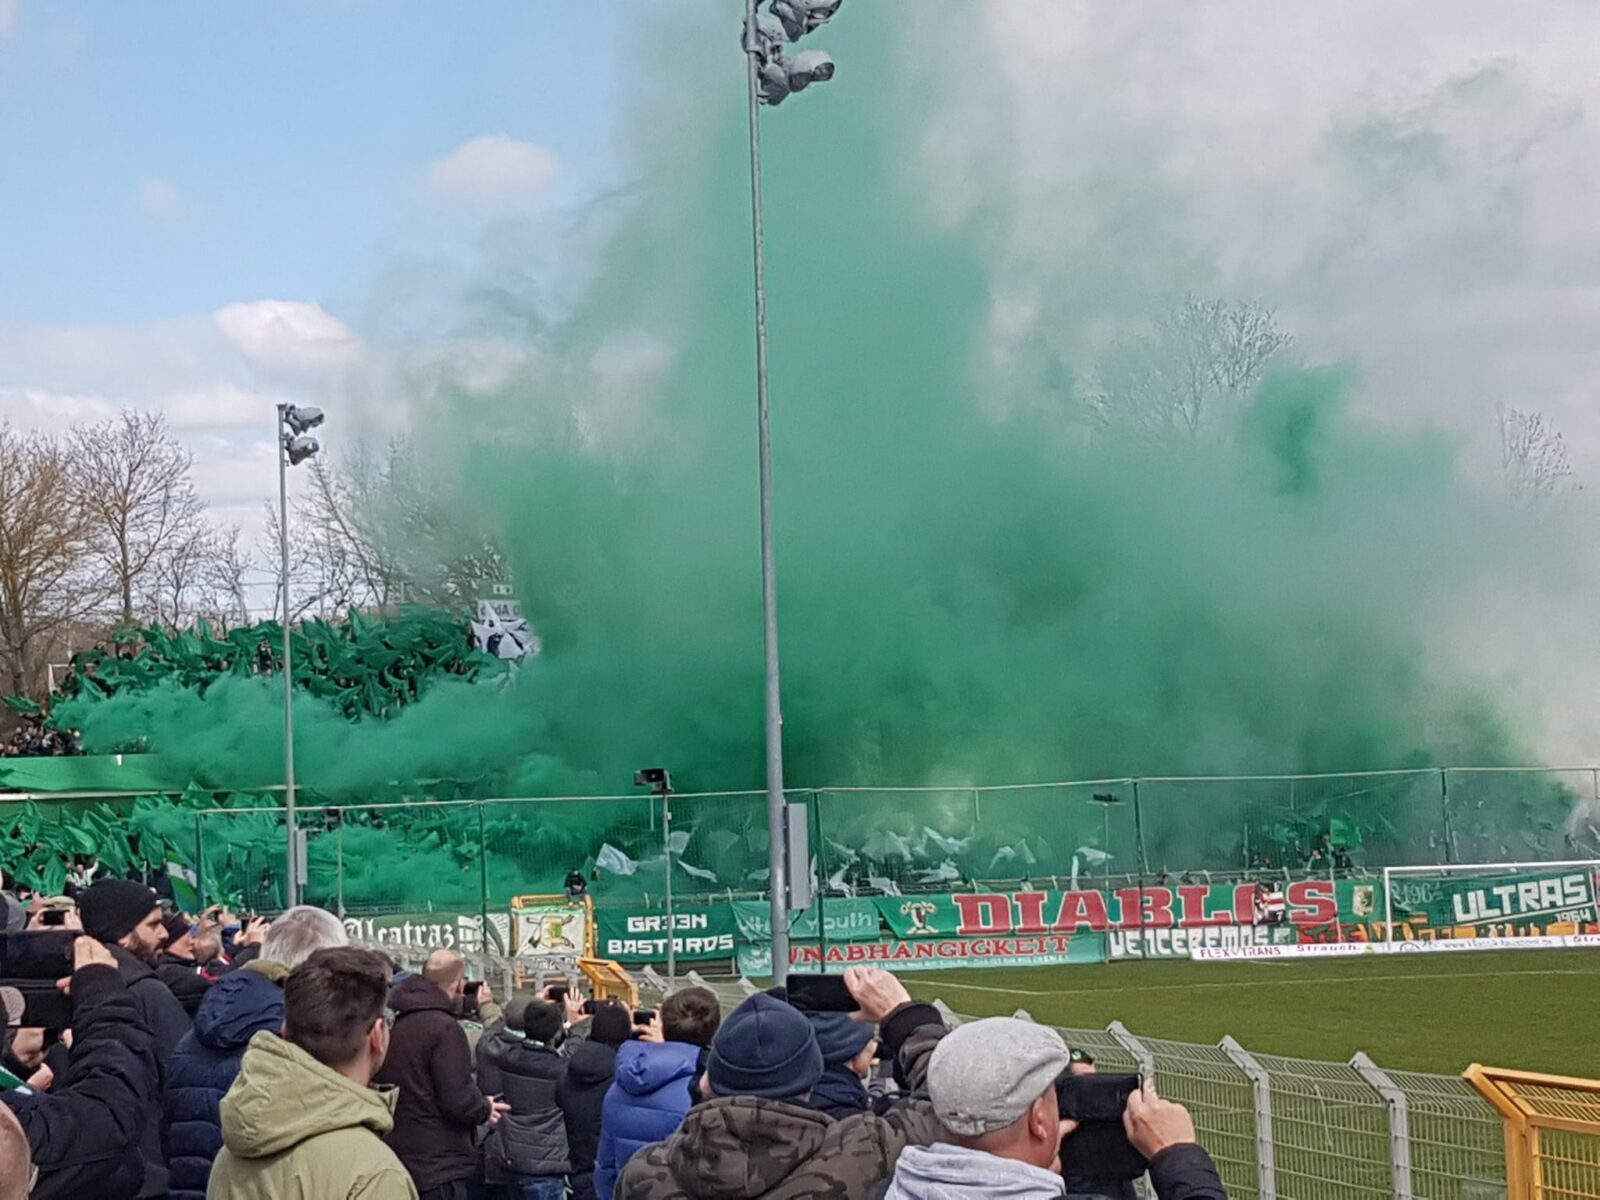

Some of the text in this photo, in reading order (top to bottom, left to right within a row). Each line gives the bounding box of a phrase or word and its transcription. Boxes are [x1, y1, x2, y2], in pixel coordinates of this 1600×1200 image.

[1453, 874, 1588, 922] ULTRAS
[342, 917, 456, 949] Alcatraz
[607, 934, 734, 955] BASTARDS
